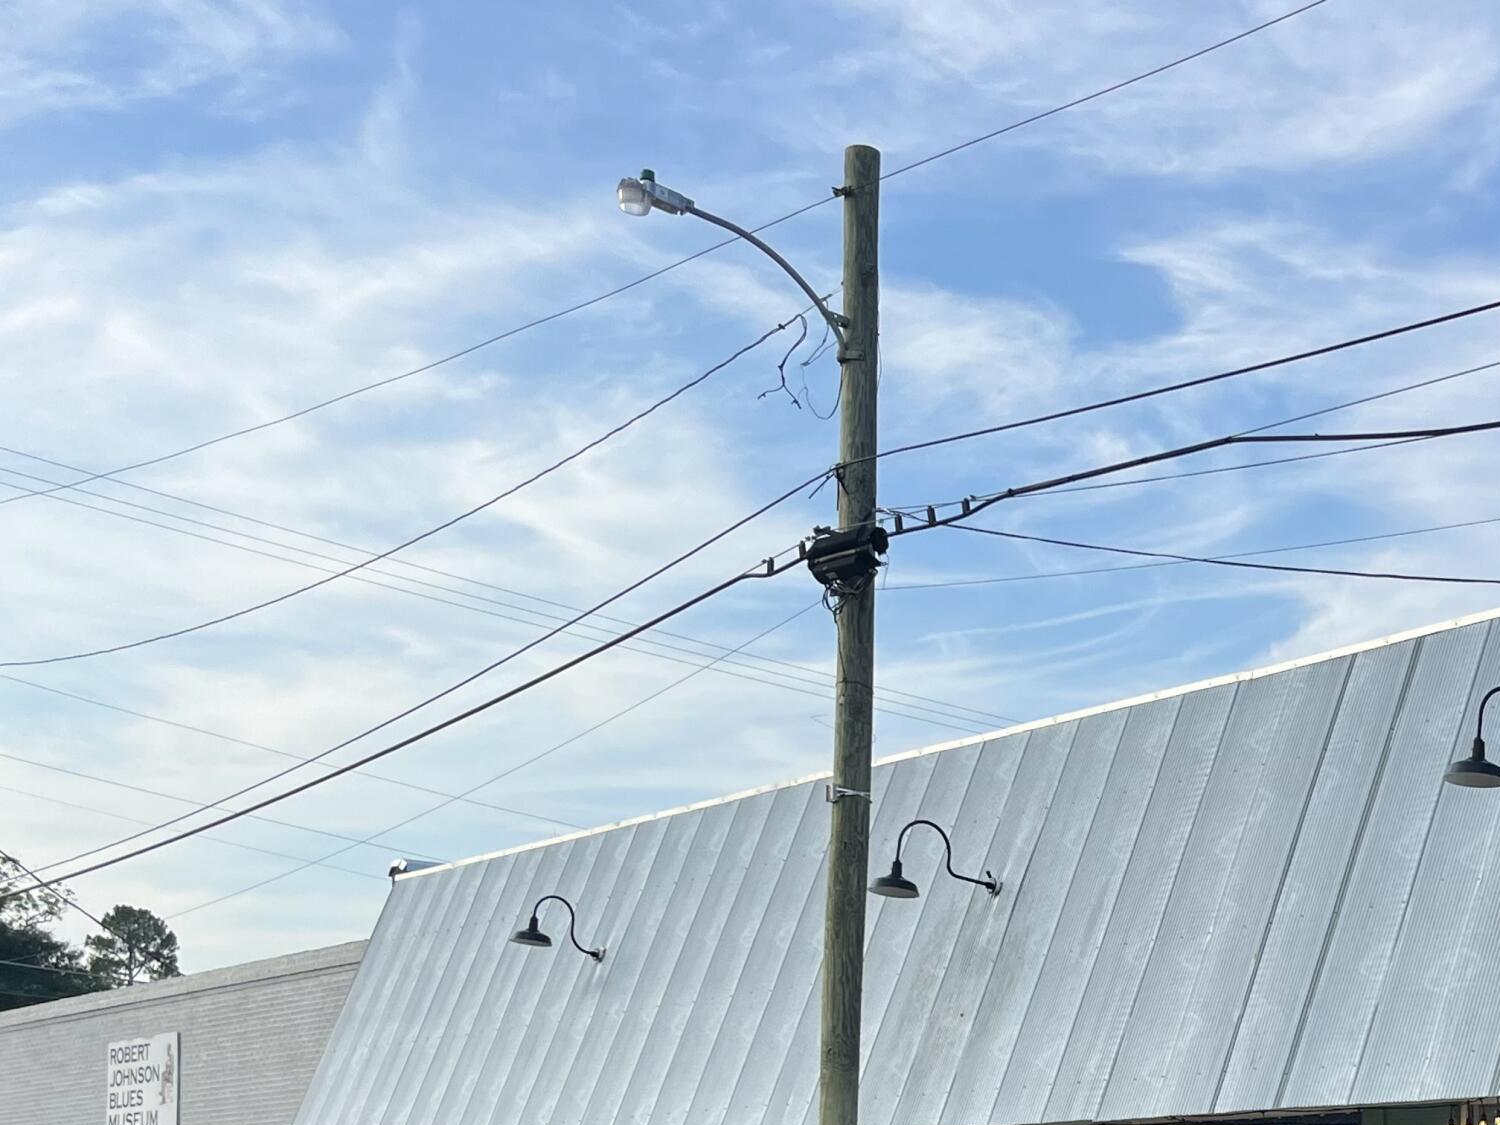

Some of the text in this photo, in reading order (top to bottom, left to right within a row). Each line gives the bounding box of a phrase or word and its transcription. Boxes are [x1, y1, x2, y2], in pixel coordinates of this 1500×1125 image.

[110, 1043, 150, 1065] ROBERT
[110, 1064, 160, 1087] JOHNSON
[109, 1090, 143, 1109] BLUES
